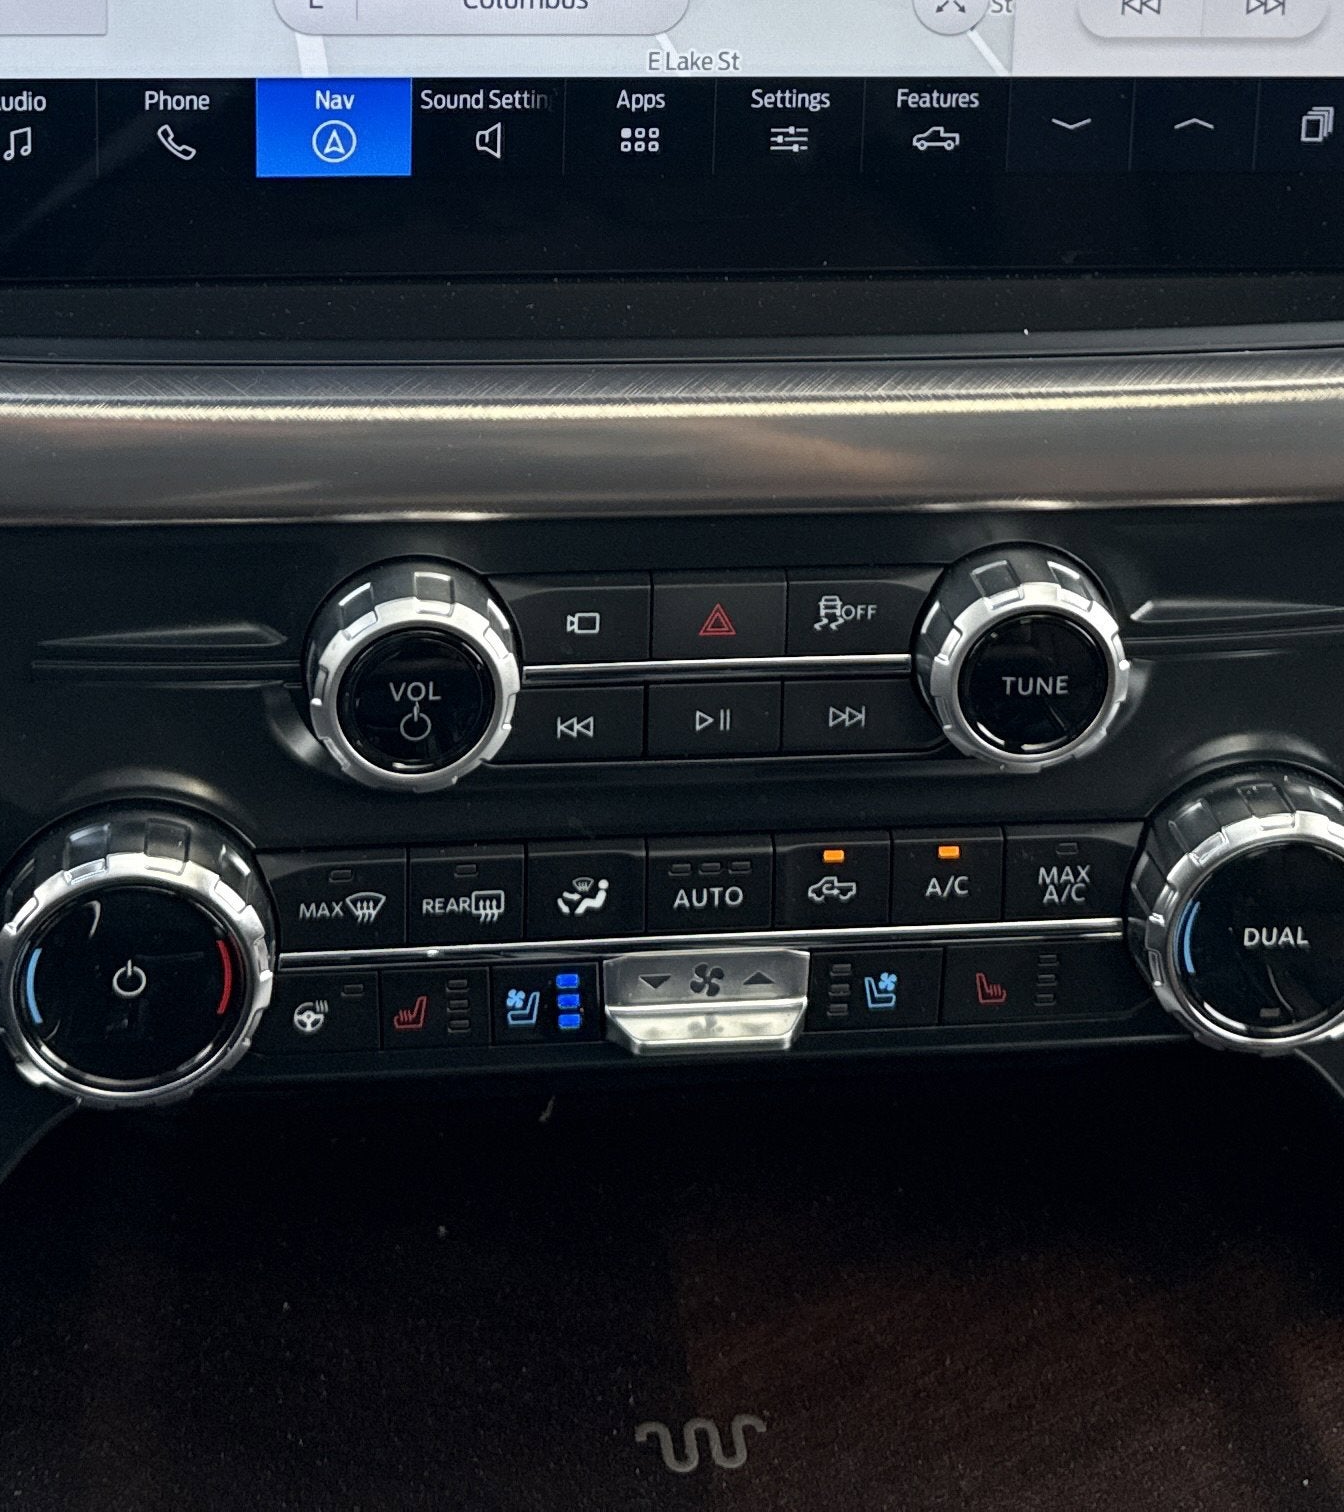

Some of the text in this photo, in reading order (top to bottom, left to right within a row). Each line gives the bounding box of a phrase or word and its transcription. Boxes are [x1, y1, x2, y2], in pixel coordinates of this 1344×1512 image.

[648, 51, 740, 72] E Lake St
[143, 90, 211, 112] Phone
[315, 91, 355, 111] Nav
[420, 88, 553, 112] Sound Settin
[616, 90, 666, 112] Apps
[750, 89, 831, 112] Settings
[896, 88, 980, 109] Features
[840, 602, 879, 623] OFF
[388, 680, 442, 703] VOL
[1000, 673, 1070, 696] TUNE
[1037, 864, 1091, 885] MAX
[672, 886, 745, 908] AUTO
[925, 876, 969, 899] A/C
[1042, 882, 1086, 904] A/C
[298, 901, 345, 920] MAX
[422, 896, 471, 916] REAR
[1243, 925, 1310, 949] DUAL
